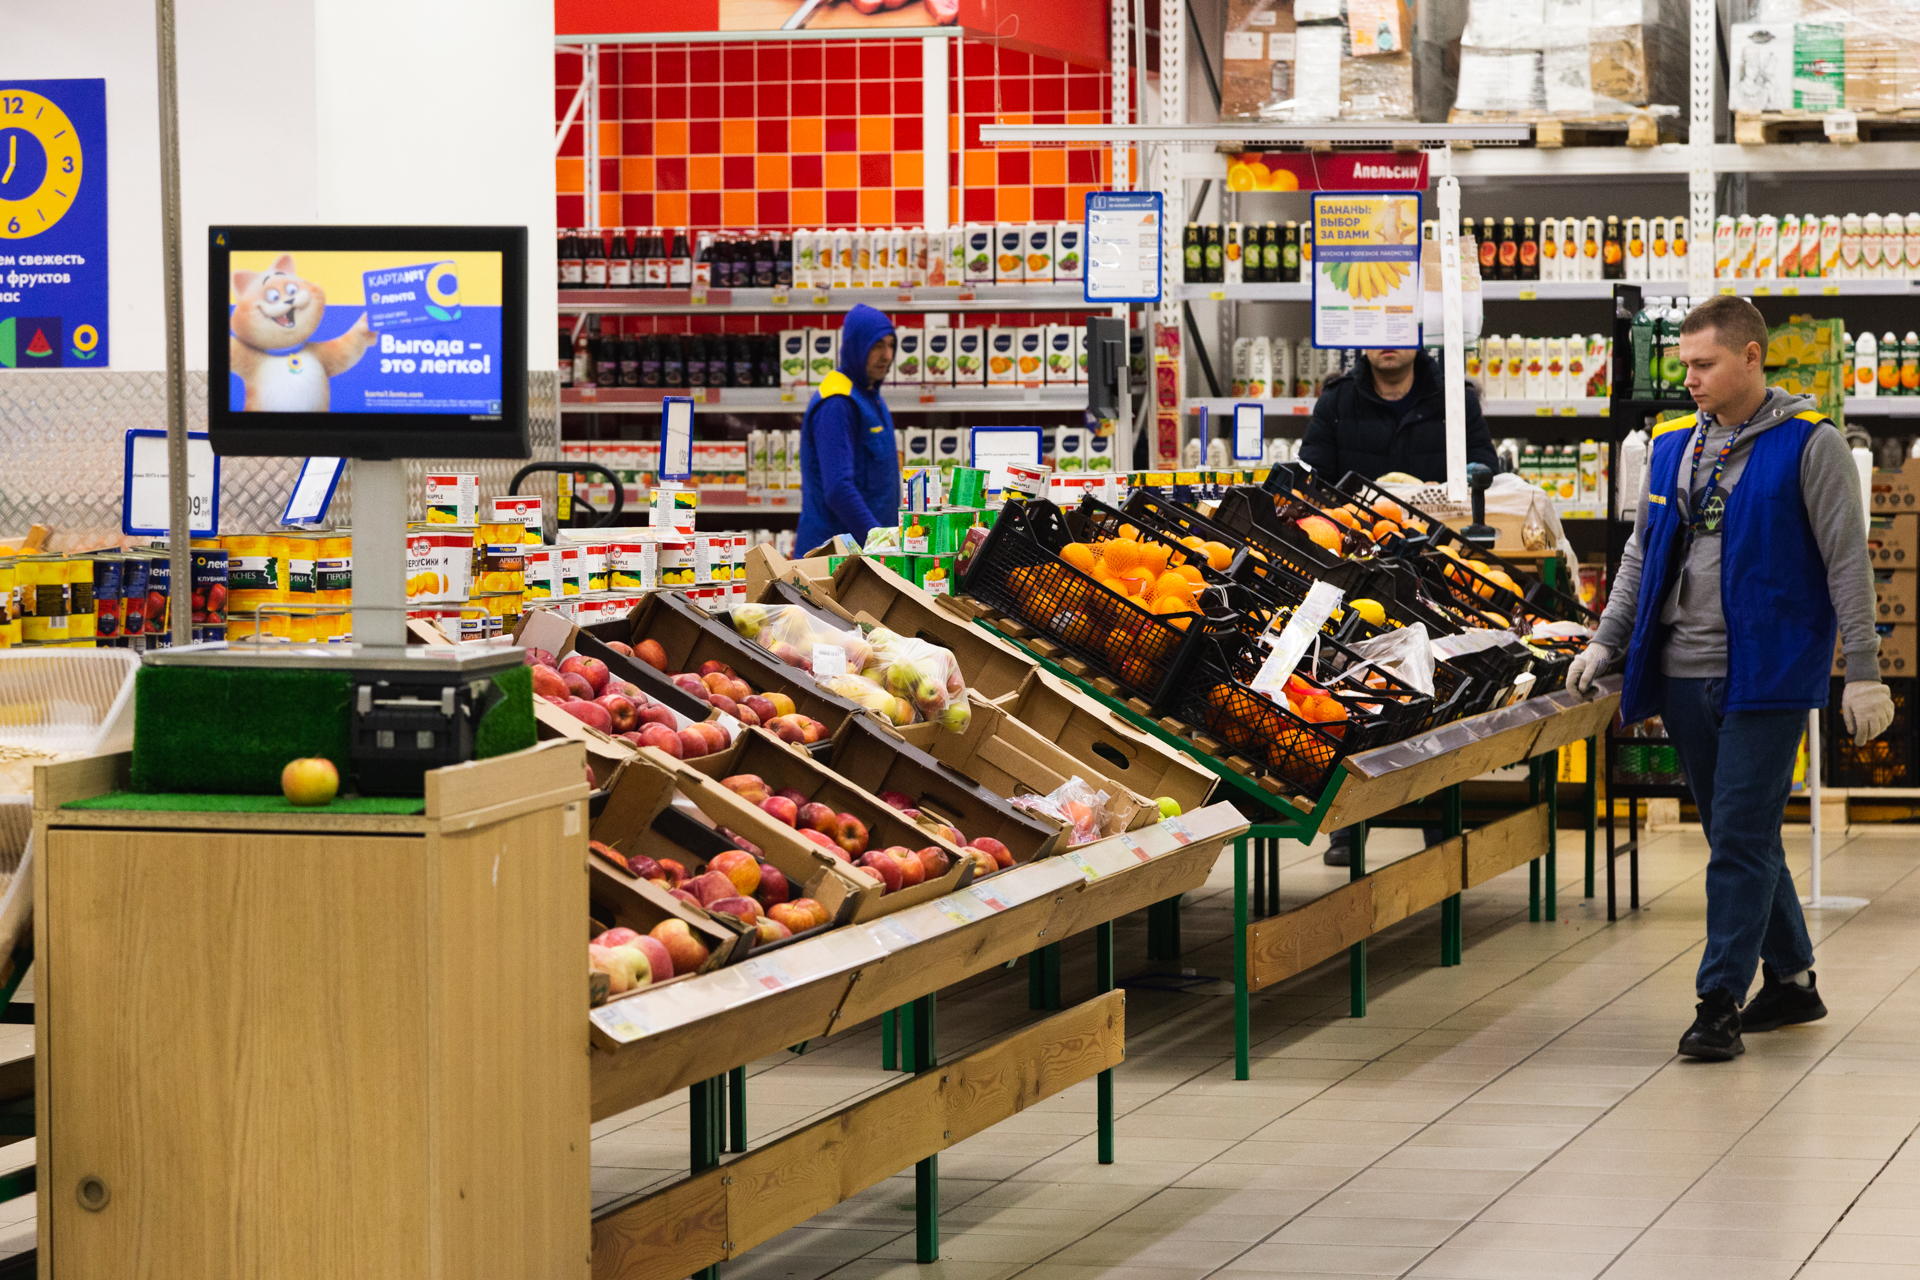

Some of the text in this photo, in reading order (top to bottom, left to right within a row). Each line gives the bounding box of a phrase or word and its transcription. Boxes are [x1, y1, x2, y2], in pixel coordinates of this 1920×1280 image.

[3, 96, 24, 114] 12
[62, 156, 74, 173] 3
[1352, 162, 1418, 179] Апельсин
[1320, 205, 1372, 215] БАНАНЫ:
[8, 217, 20, 234] 6
[1320, 218, 1360, 227] ВЫБОР
[1320, 230, 1369, 239] ЗА ВАМИ
[19, 254, 85, 266] свежесть
[7, 270, 71, 288] фруктов
[381, 291, 416, 304] лента
[381, 334, 464, 357] Выгода
[380, 354, 491, 374] это легко!
[420, 558, 439, 566] СИКИ
